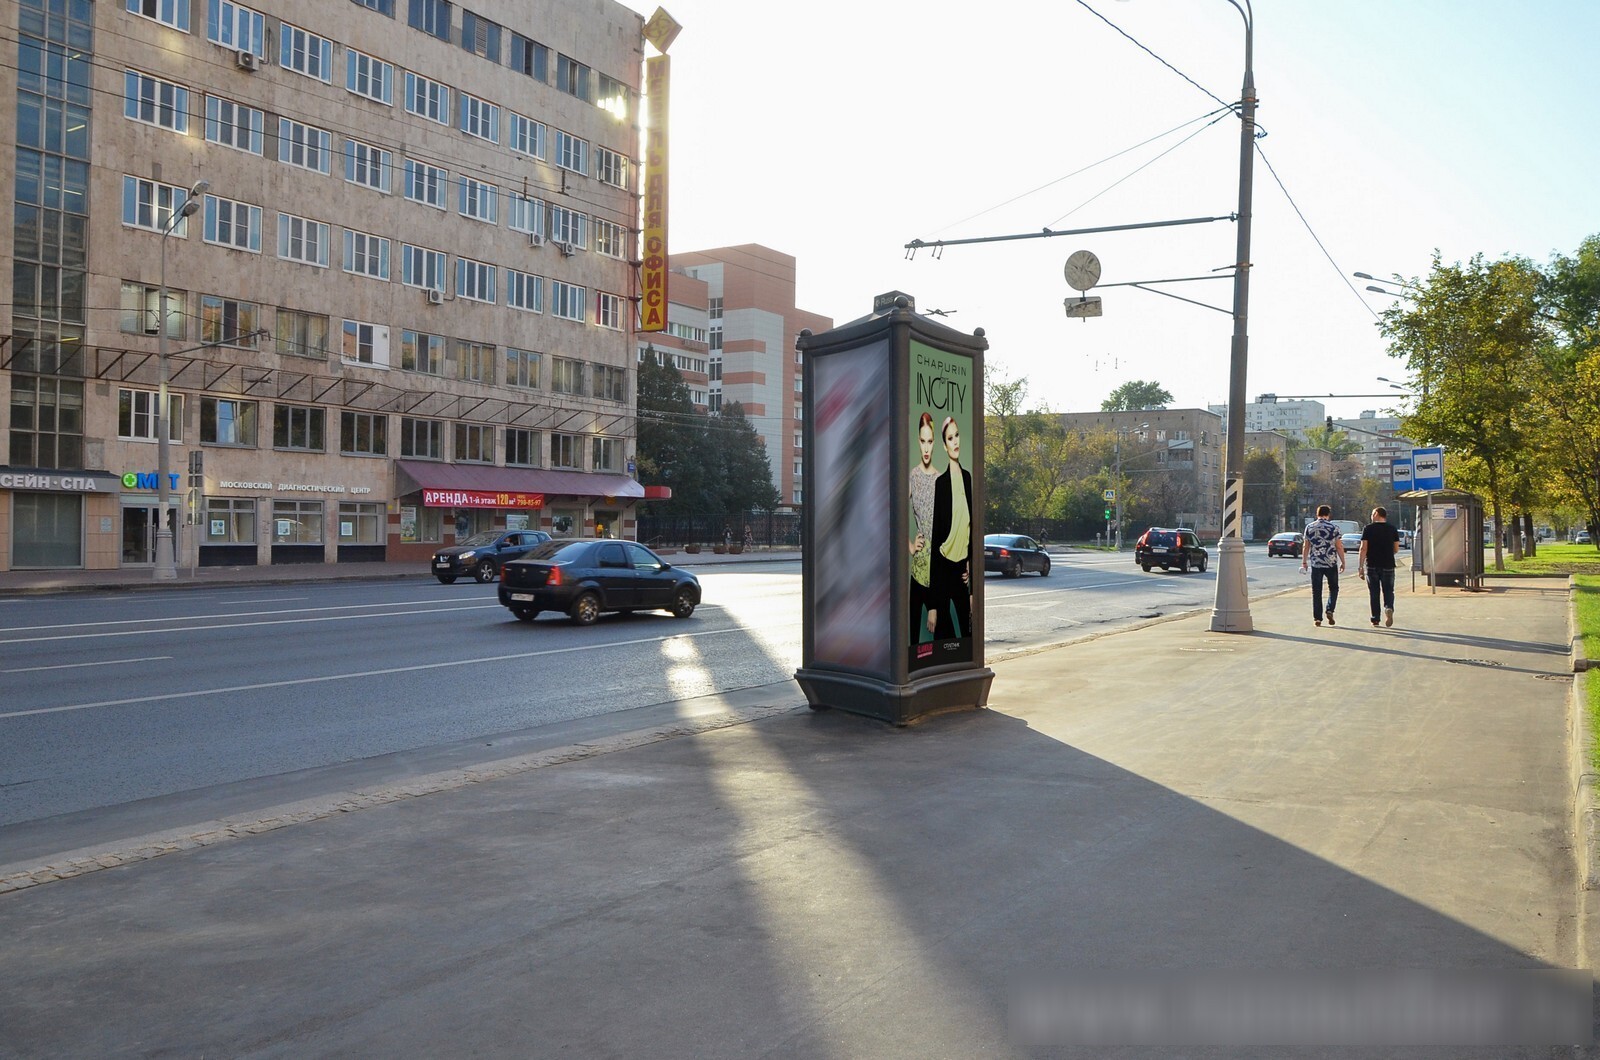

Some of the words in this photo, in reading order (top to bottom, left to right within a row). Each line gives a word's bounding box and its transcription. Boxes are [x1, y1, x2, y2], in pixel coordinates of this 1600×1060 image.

[648, 174, 664, 229] ДЛЯ
[645, 236, 664, 325] ОФИСА
[916, 353, 967, 377] CHAPURIN
[916, 371, 967, 415] INCITY
[0, 473, 50, 489] СЕЙН
[60, 477, 97, 490] СПА
[136, 473, 180, 489] МТ
[220, 481, 272, 490] МОСКОВСКИЙ
[278, 483, 345, 493] ДИАГНОСТИЧЕСКИЙ
[350, 486, 371, 495] ЦЕНТР
[425, 492, 469, 505] АРЕНДА
[496, 493, 509, 505] 120
